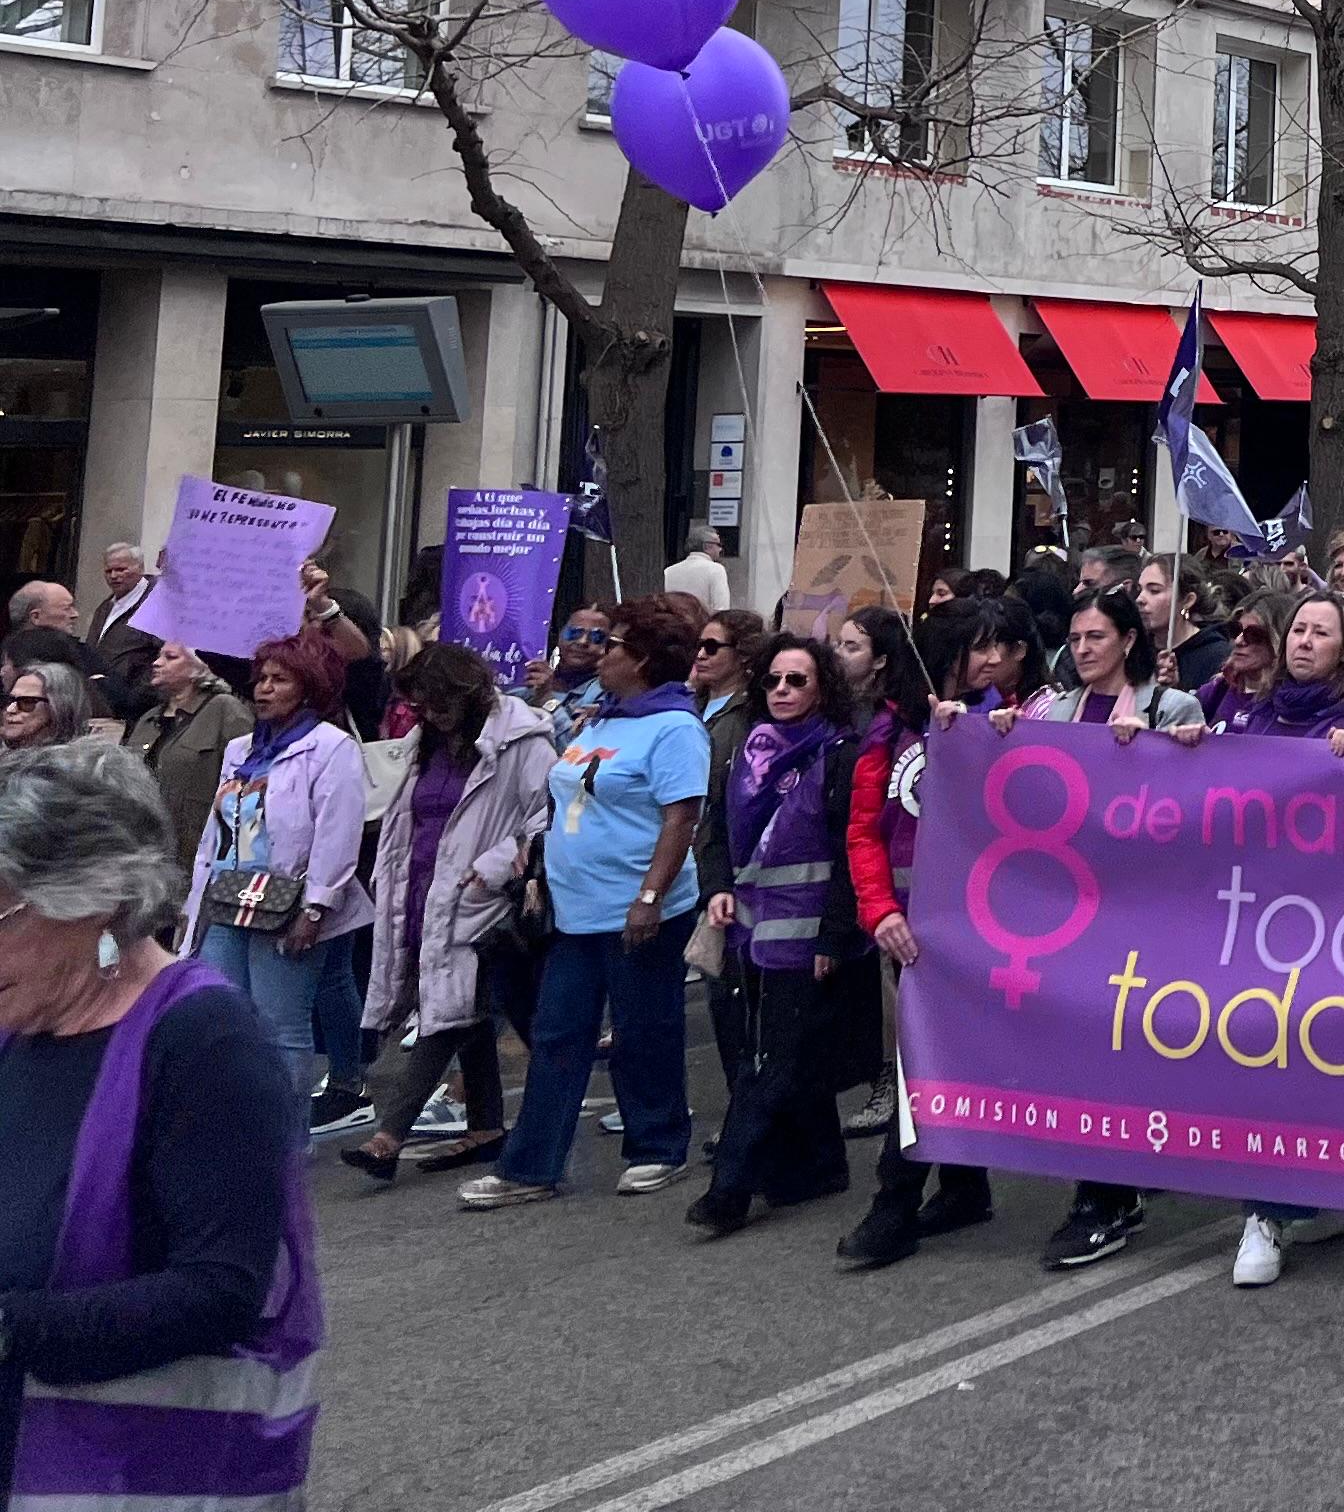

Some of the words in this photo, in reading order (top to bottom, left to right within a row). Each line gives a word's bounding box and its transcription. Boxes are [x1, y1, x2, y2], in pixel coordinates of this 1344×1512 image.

[242, 430, 289, 439] JAVIER
[293, 430, 351, 439] SIMORRA
[966, 744, 1099, 966] 8
[1103, 783, 1183, 843] de
[1079, 1111, 1131, 1140] DEL
[1188, 1126, 1223, 1152] DE
